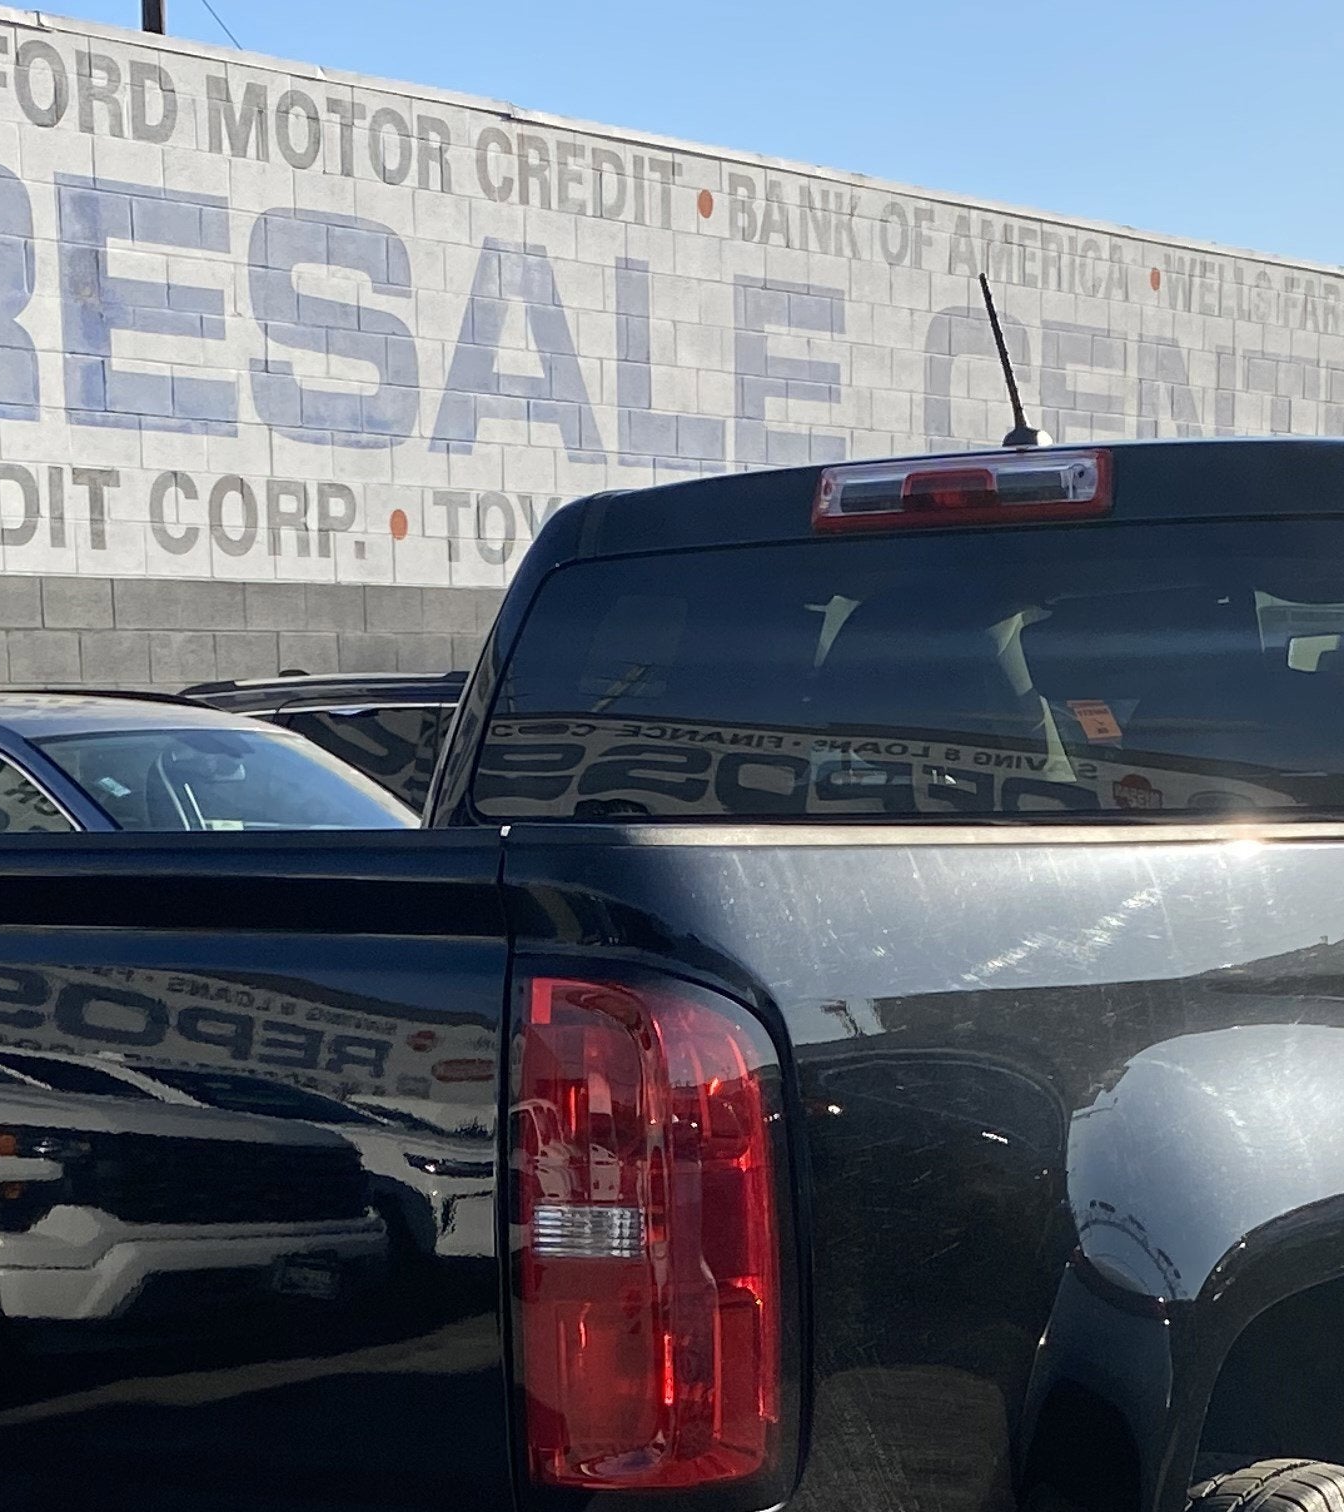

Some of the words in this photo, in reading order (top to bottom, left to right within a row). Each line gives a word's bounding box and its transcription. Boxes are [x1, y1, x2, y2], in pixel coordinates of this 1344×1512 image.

[206, 74, 453, 194] MOTOR
[475, 126, 683, 231] CREDIT
[728, 172, 861, 260] BANK
[879, 201, 935, 269] OF
[949, 214, 1130, 302] AMERICA
[1163, 252, 1273, 323] WELLS
[149, 468, 367, 560] CORP.
